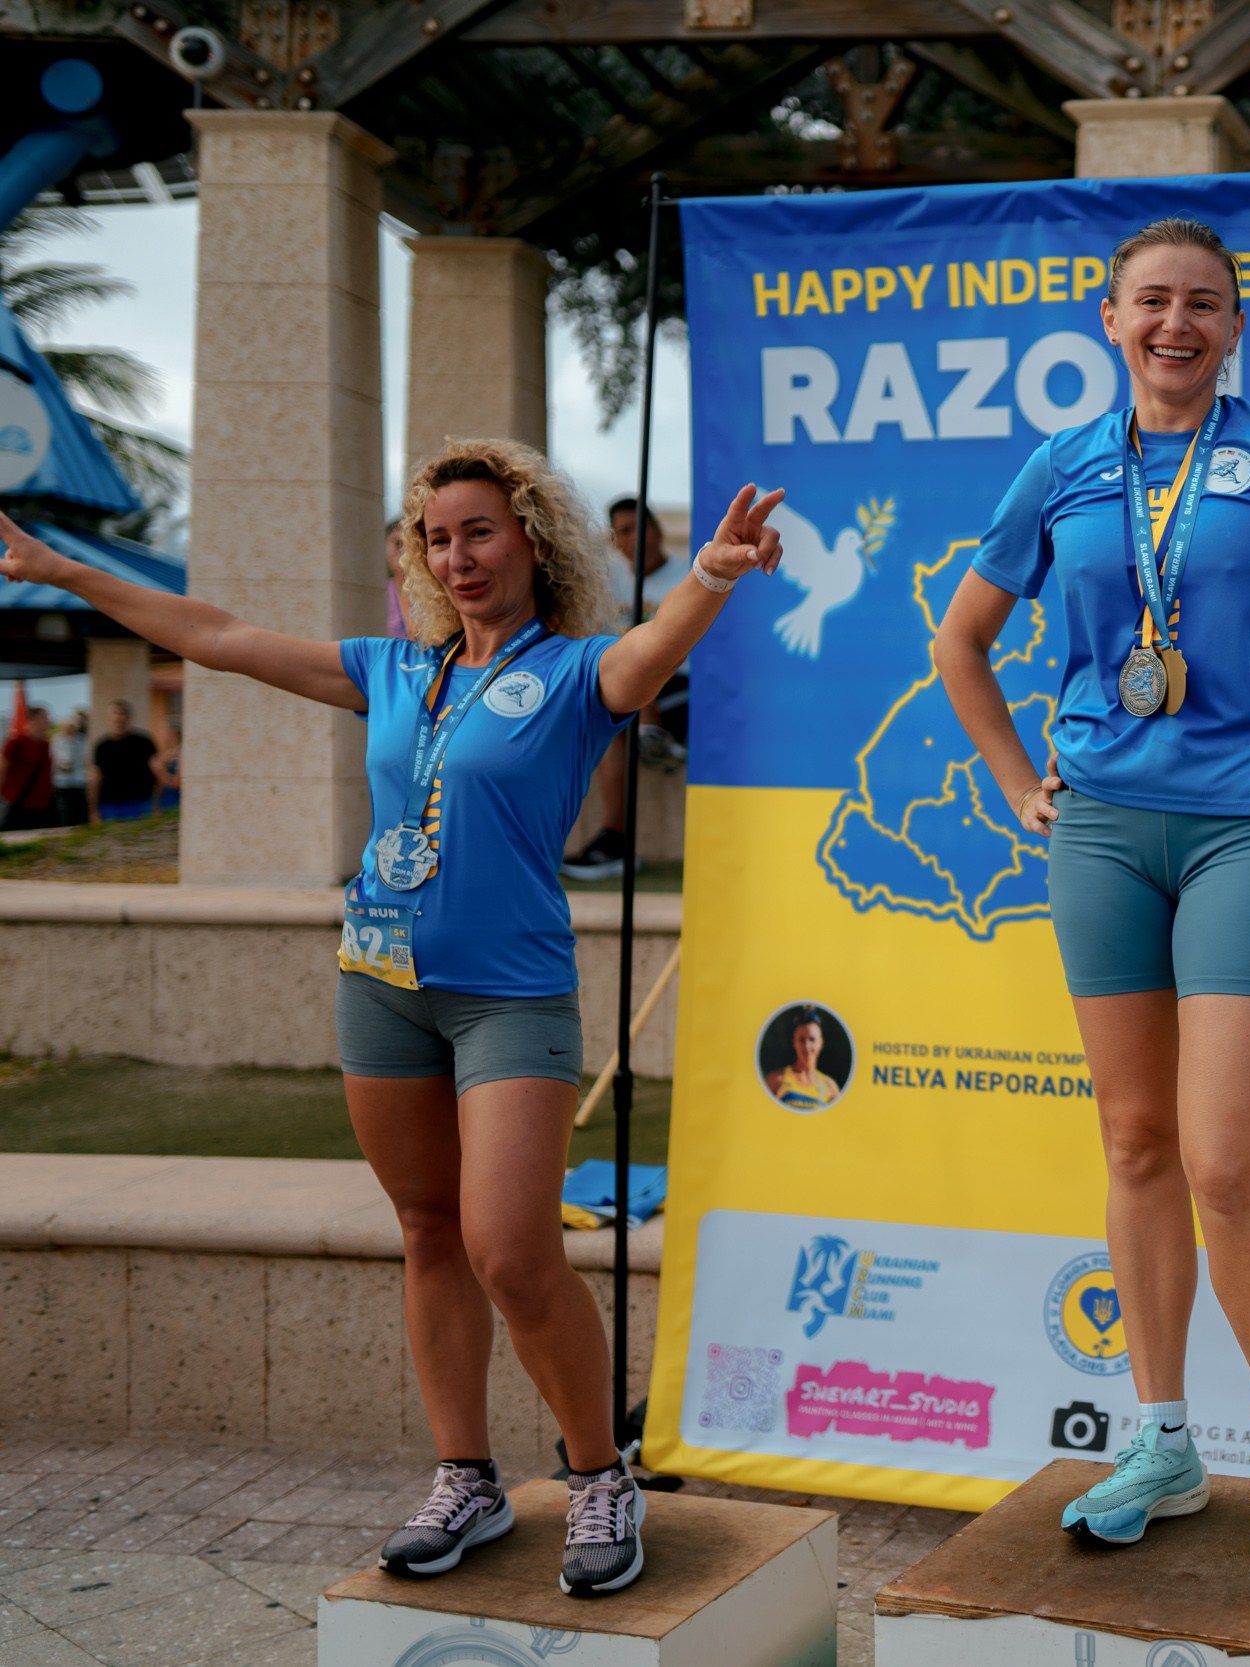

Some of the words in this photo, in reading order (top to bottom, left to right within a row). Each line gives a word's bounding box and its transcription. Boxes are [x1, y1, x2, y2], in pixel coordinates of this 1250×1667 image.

[753, 264, 934, 317] HAPPY
[1131, 464, 1140, 486] SLAVA
[1184, 493, 1196, 515] SLAVA
[1140, 543, 1150, 567] SLAVA
[1166, 577, 1177, 603] SLAVA
[420, 763, 434, 786] SLAVA
[408, 833, 428, 863] 2
[368, 908, 399, 919] RUN
[393, 928, 406, 937] 5K
[872, 1042, 929, 1057] HOSTED
[933, 1045, 952, 1058] BY
[955, 1046, 1033, 1063] UKRAINIAN
[1037, 1052, 1087, 1066] OLYMP
[872, 1064, 947, 1090] NELYA
[955, 1070, 1096, 1099] NEPORADN
[857, 1268, 923, 1290] RUNNING
